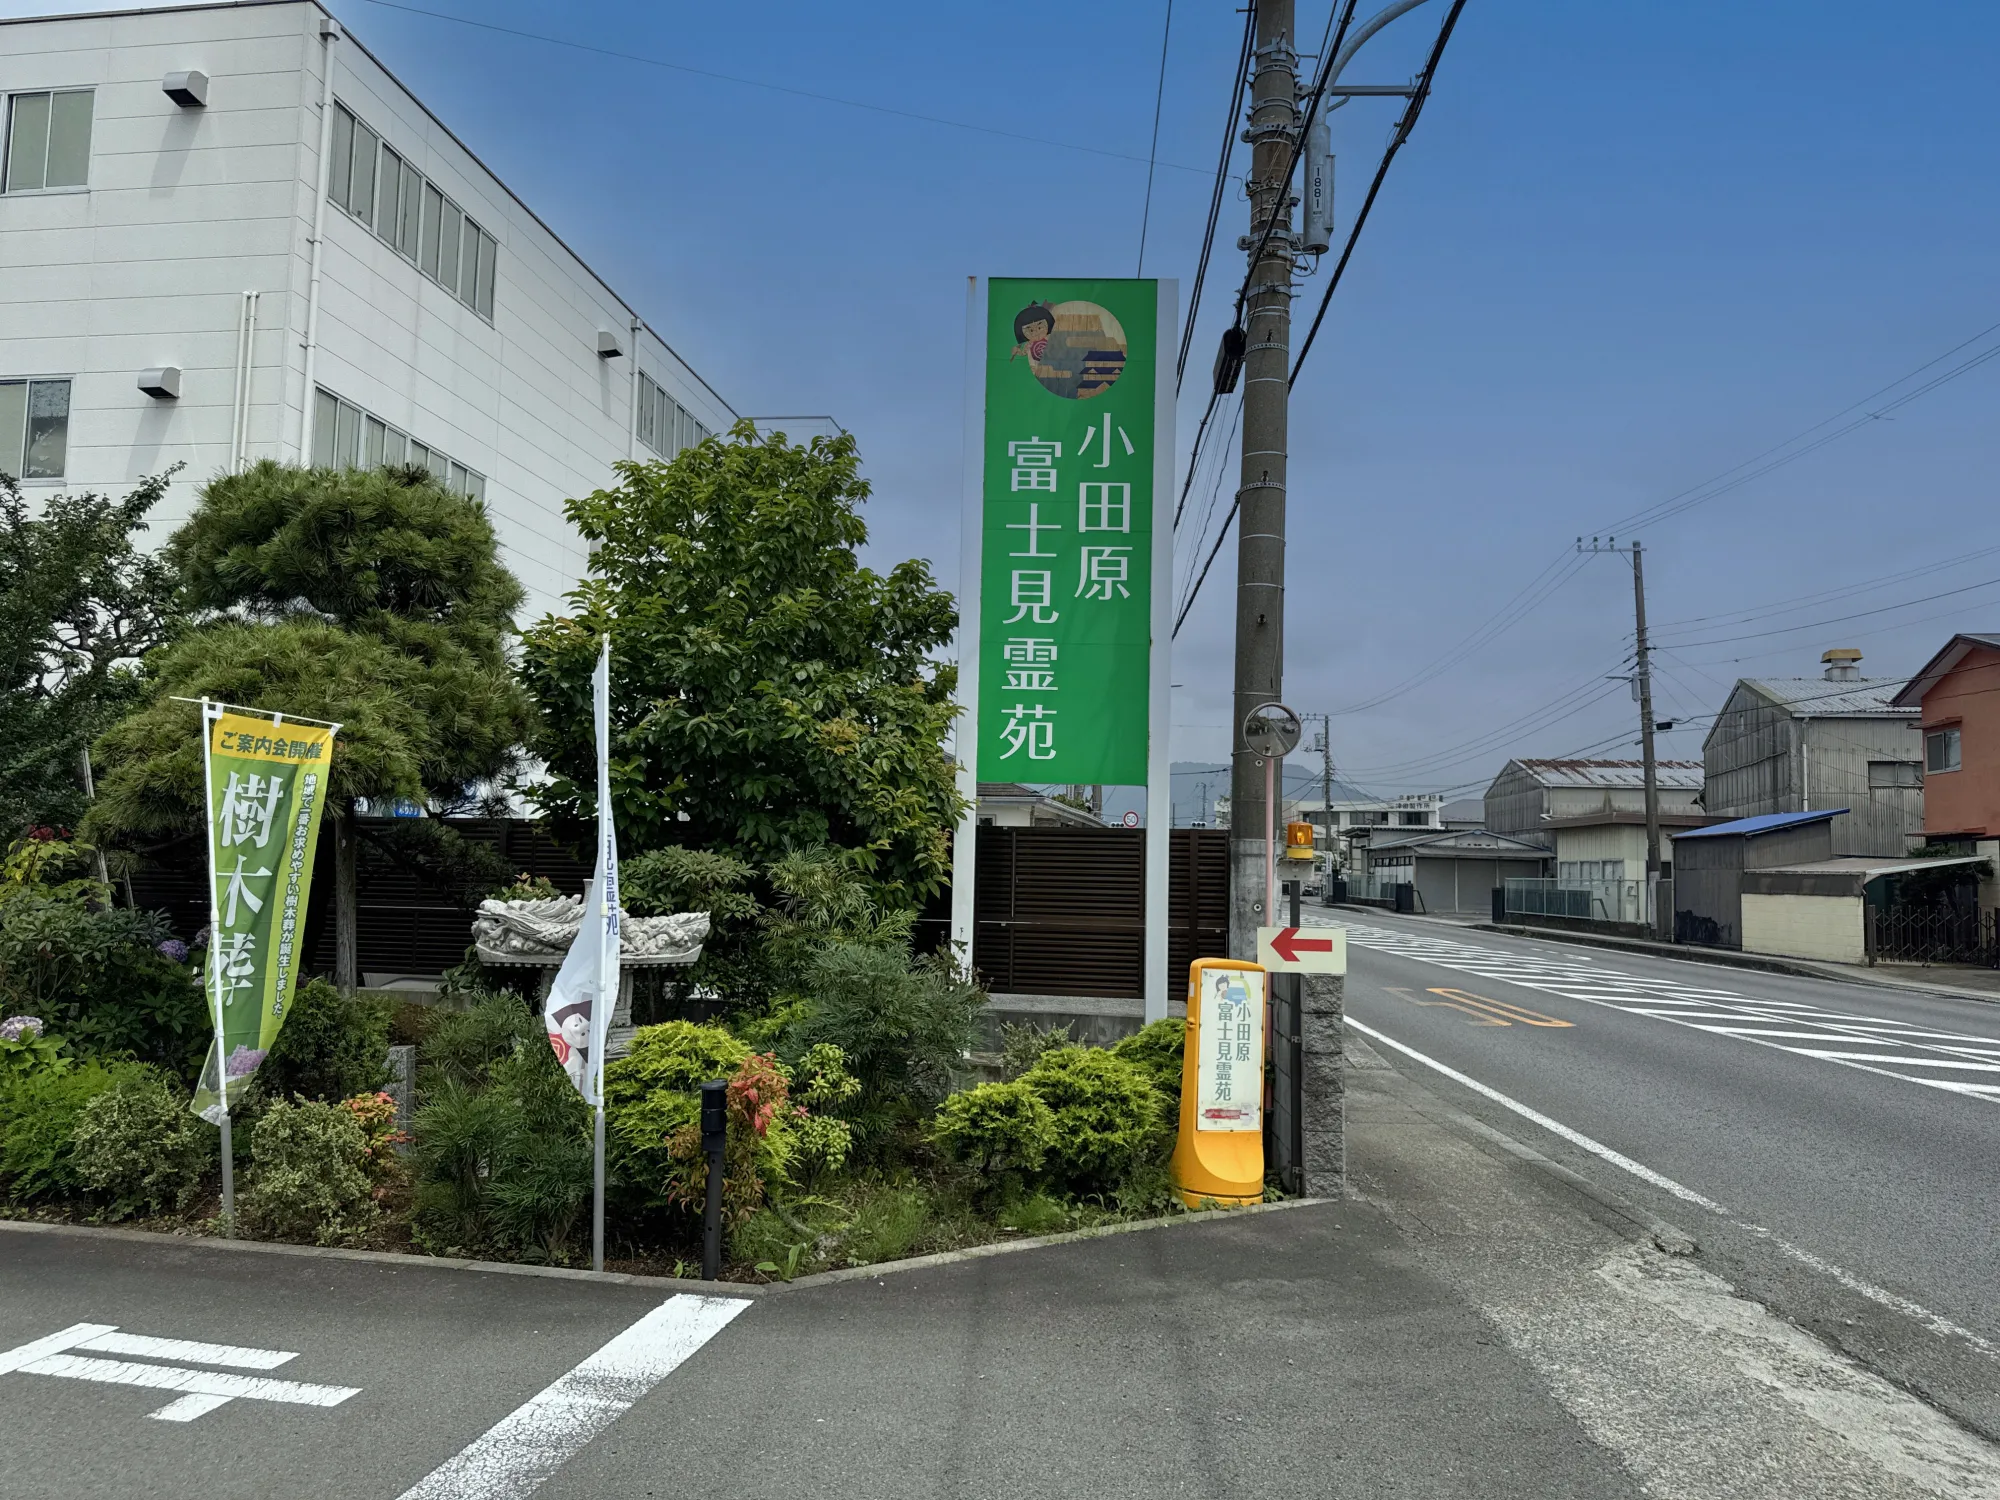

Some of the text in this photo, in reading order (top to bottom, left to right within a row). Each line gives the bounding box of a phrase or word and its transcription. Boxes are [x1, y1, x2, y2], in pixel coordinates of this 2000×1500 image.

[1313, 166, 1322, 209] 1881
[1074, 411, 1136, 601] 小田原
[998, 435, 1063, 761] 富士見霊苑
[220, 730, 324, 760] ご案内会開催
[1126, 815, 1136, 824] 50
[208, 770, 284, 1009] 樹木葬
[272, 773, 317, 1020] 地域で一番お求めやすい樹木葬が誕生しました。
[1214, 1002, 1234, 1102] 富士見霊苑
[1235, 1002, 1252, 1062] 小田原
